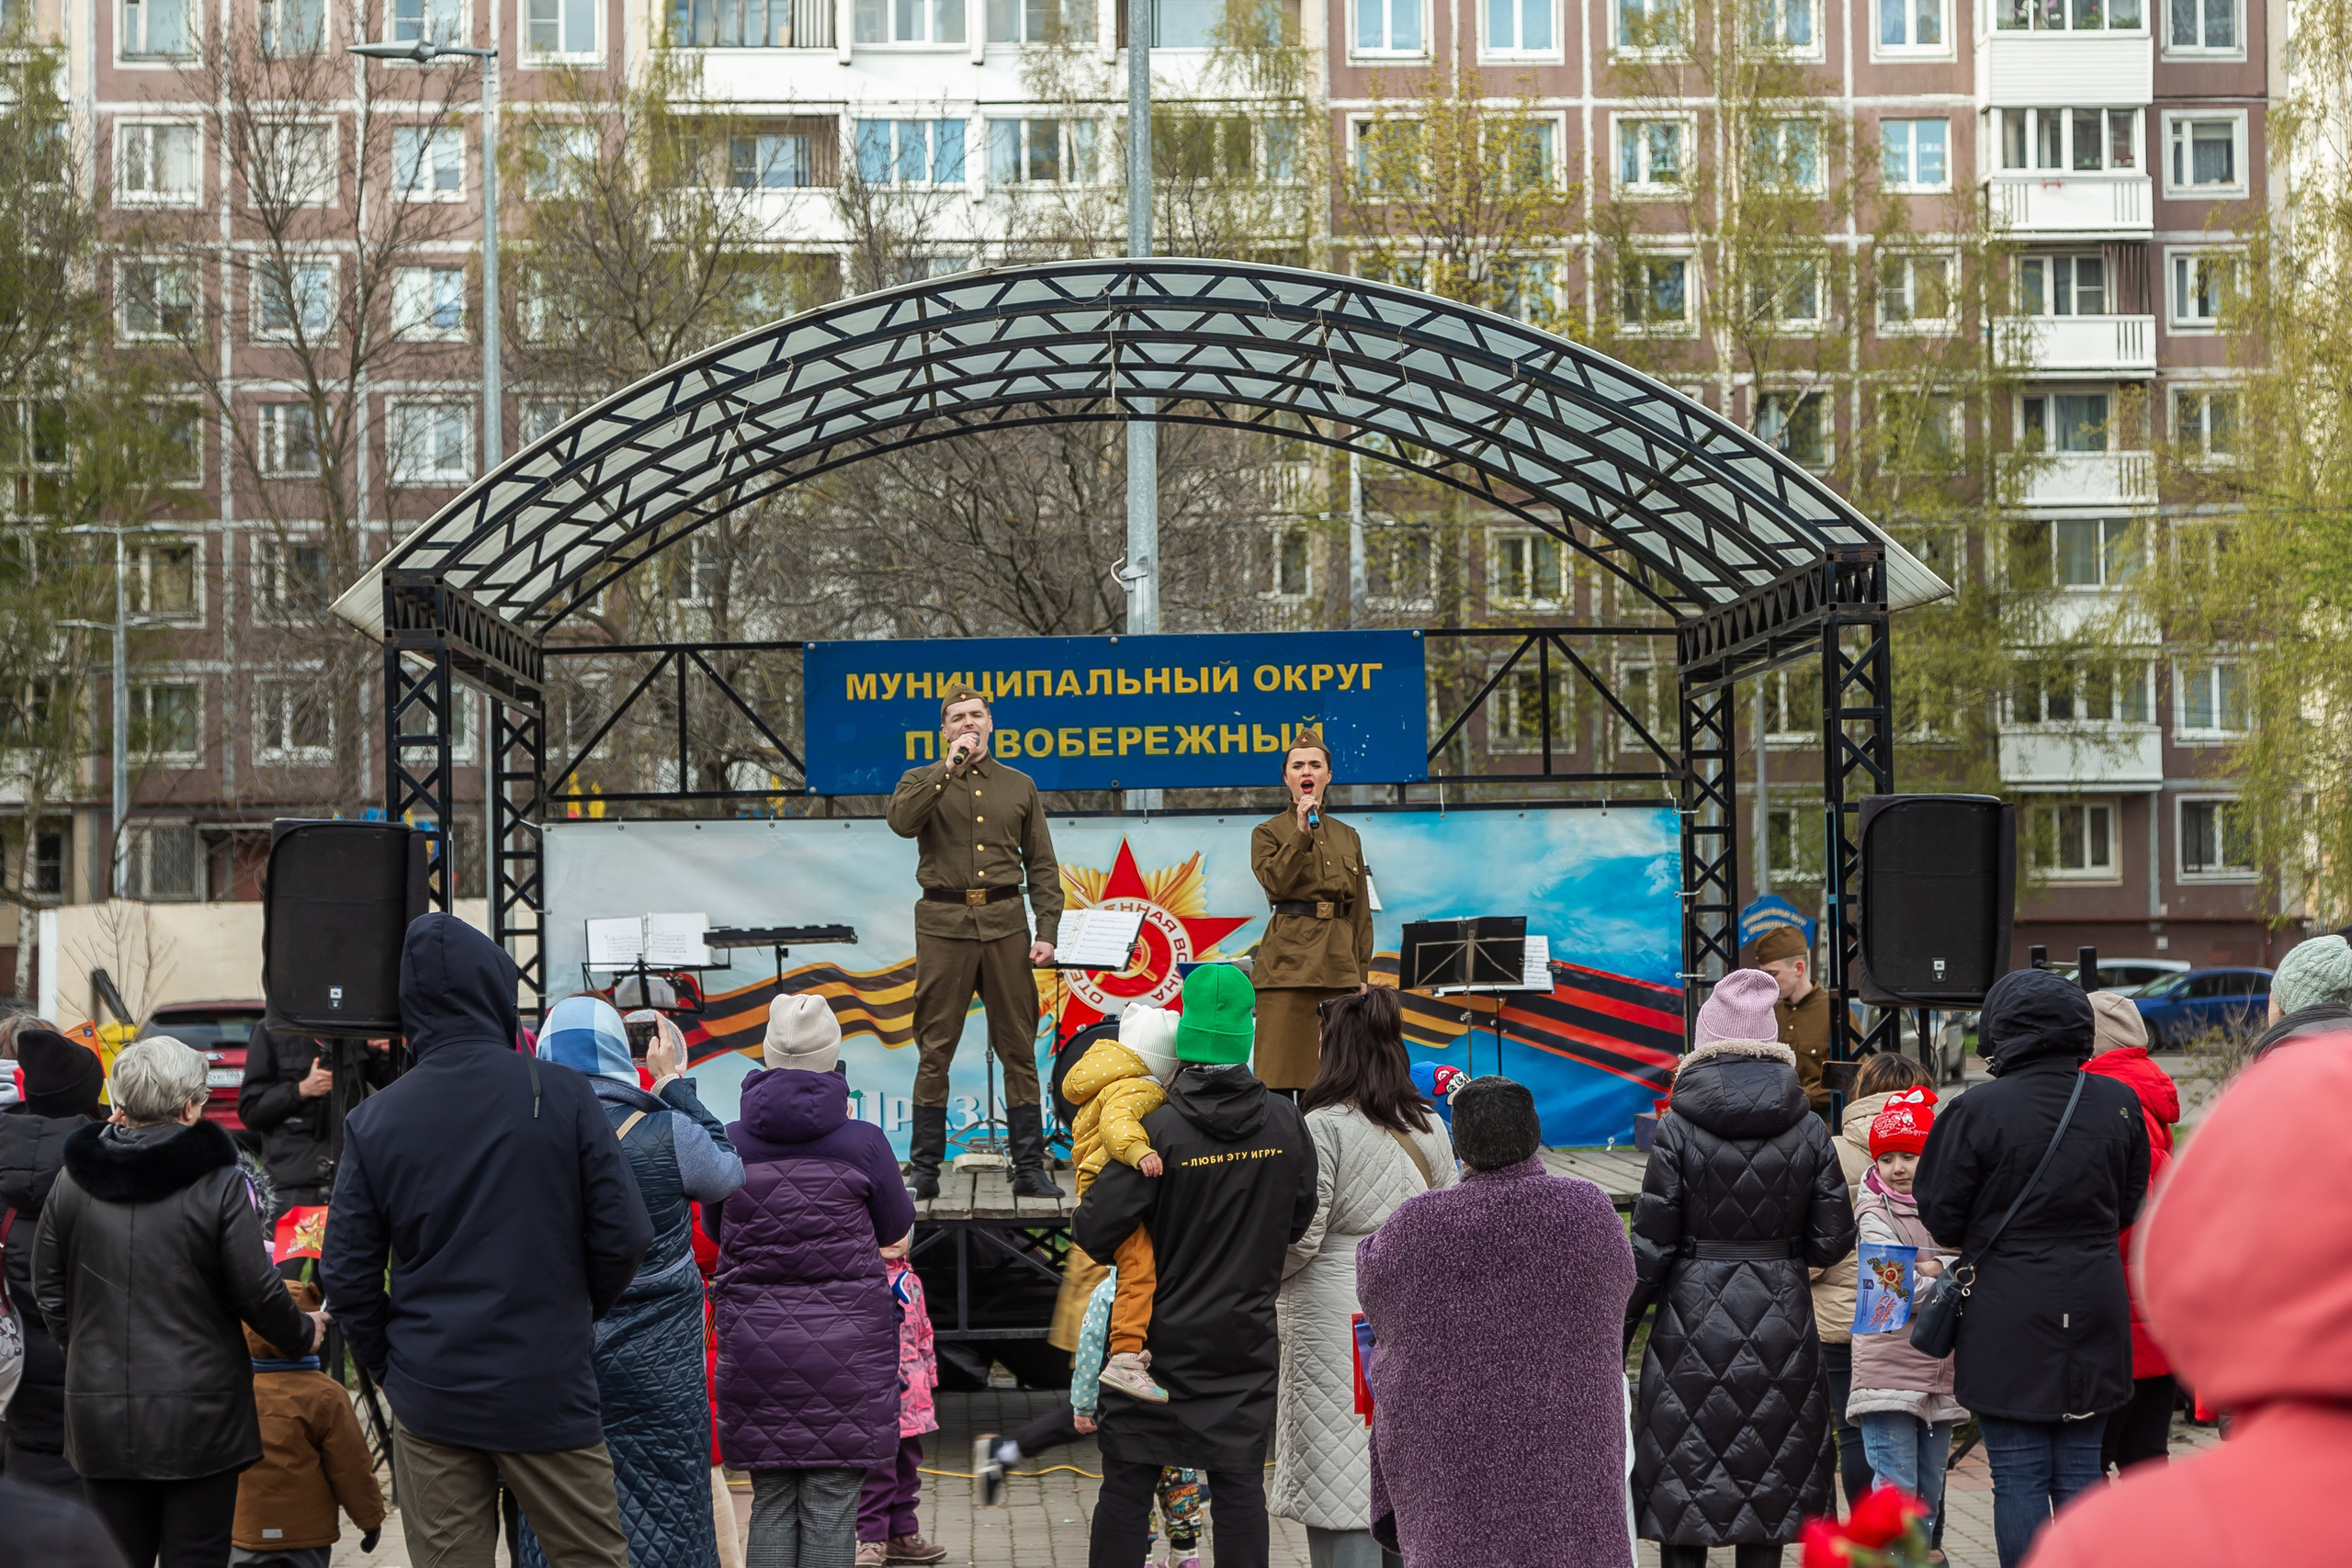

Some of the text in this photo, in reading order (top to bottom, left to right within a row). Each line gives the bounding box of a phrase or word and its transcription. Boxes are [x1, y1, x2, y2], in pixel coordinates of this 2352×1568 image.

[845, 660, 1383, 703] МУНИЦИПАЛЬНЫЙ ОКРУГ
[1227, 1151, 1248, 1162] ЭТУ
